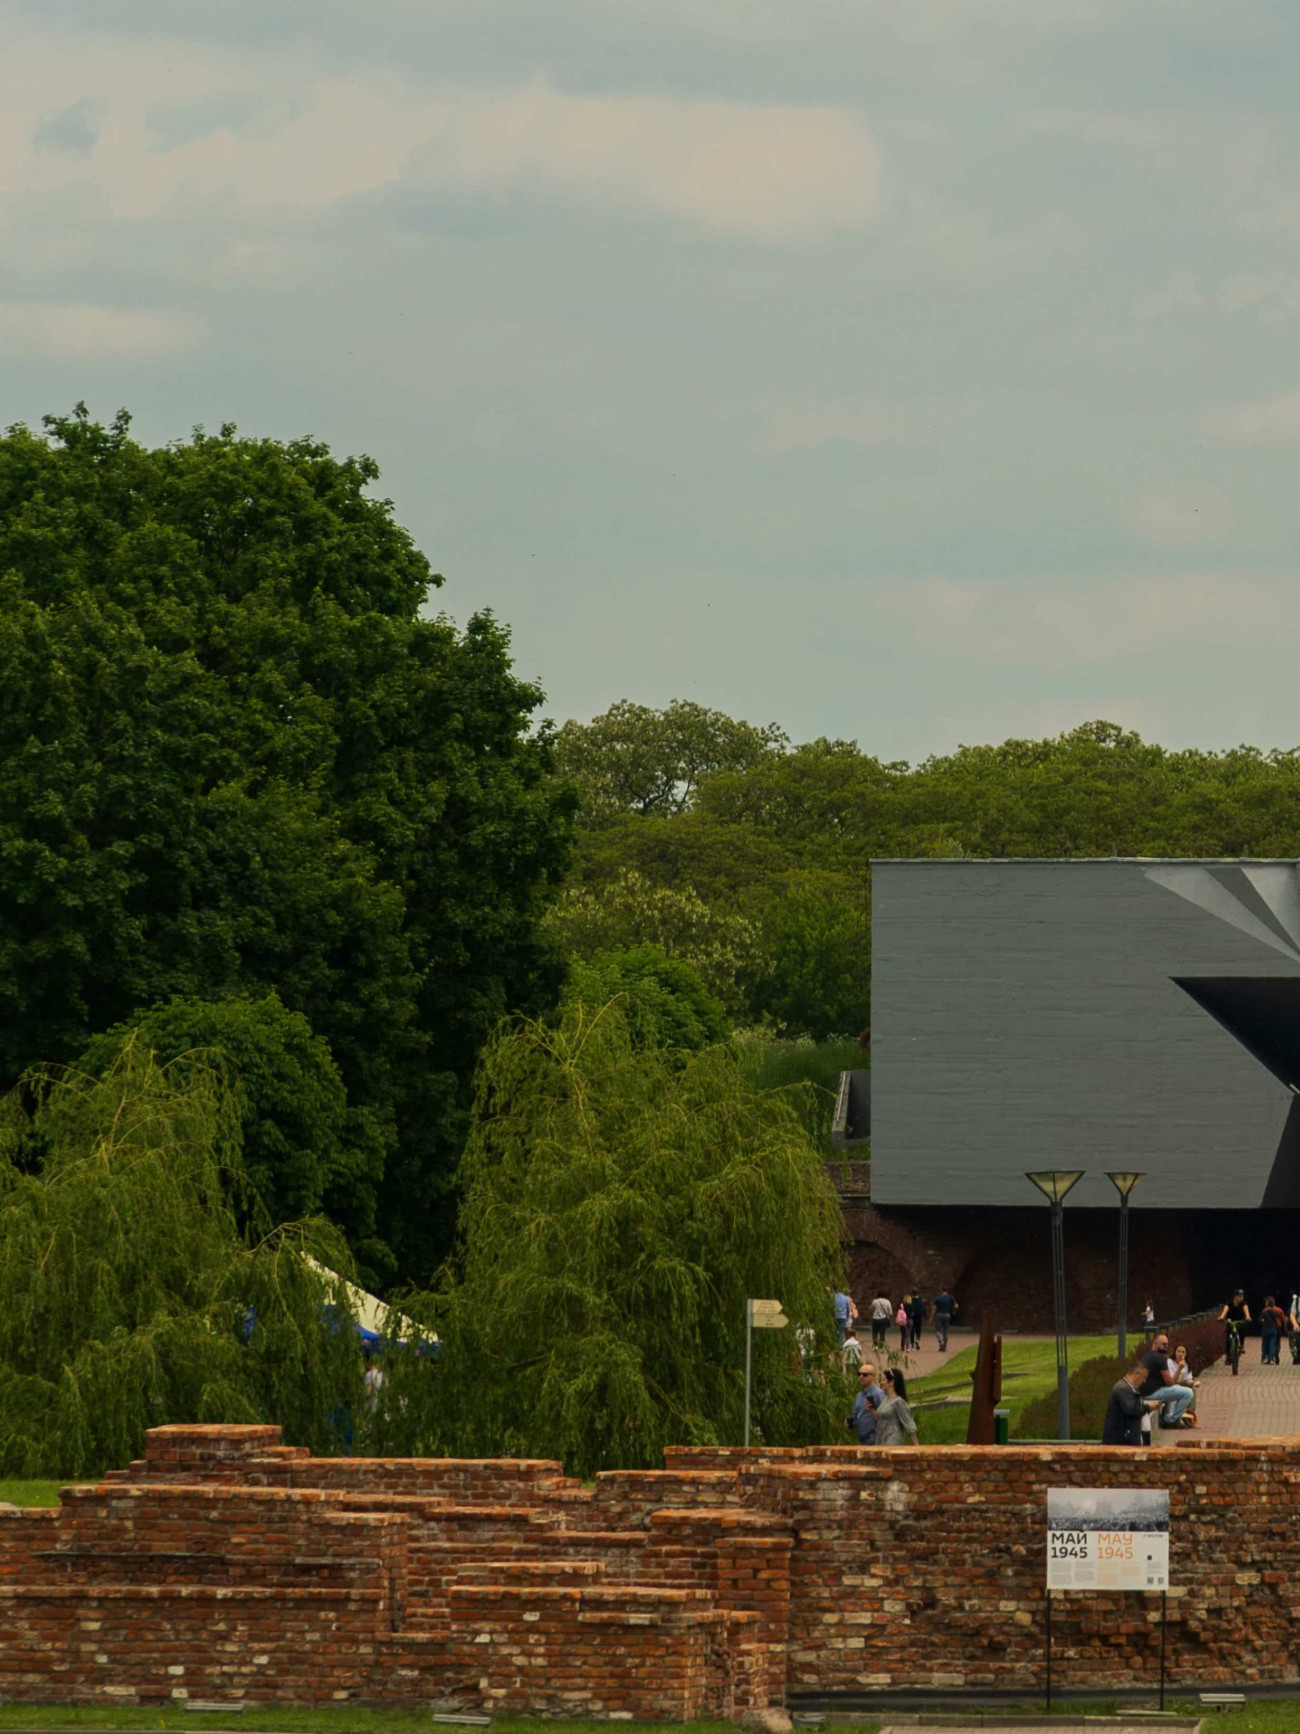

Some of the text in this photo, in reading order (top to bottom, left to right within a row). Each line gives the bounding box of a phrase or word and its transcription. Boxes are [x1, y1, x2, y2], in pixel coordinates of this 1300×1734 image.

[1051, 1530, 1087, 1544] МАЙ
[1097, 1533, 1133, 1545] MAY
[1051, 1546, 1088, 1558] 1945
[1097, 1546, 1134, 1559] 1945
